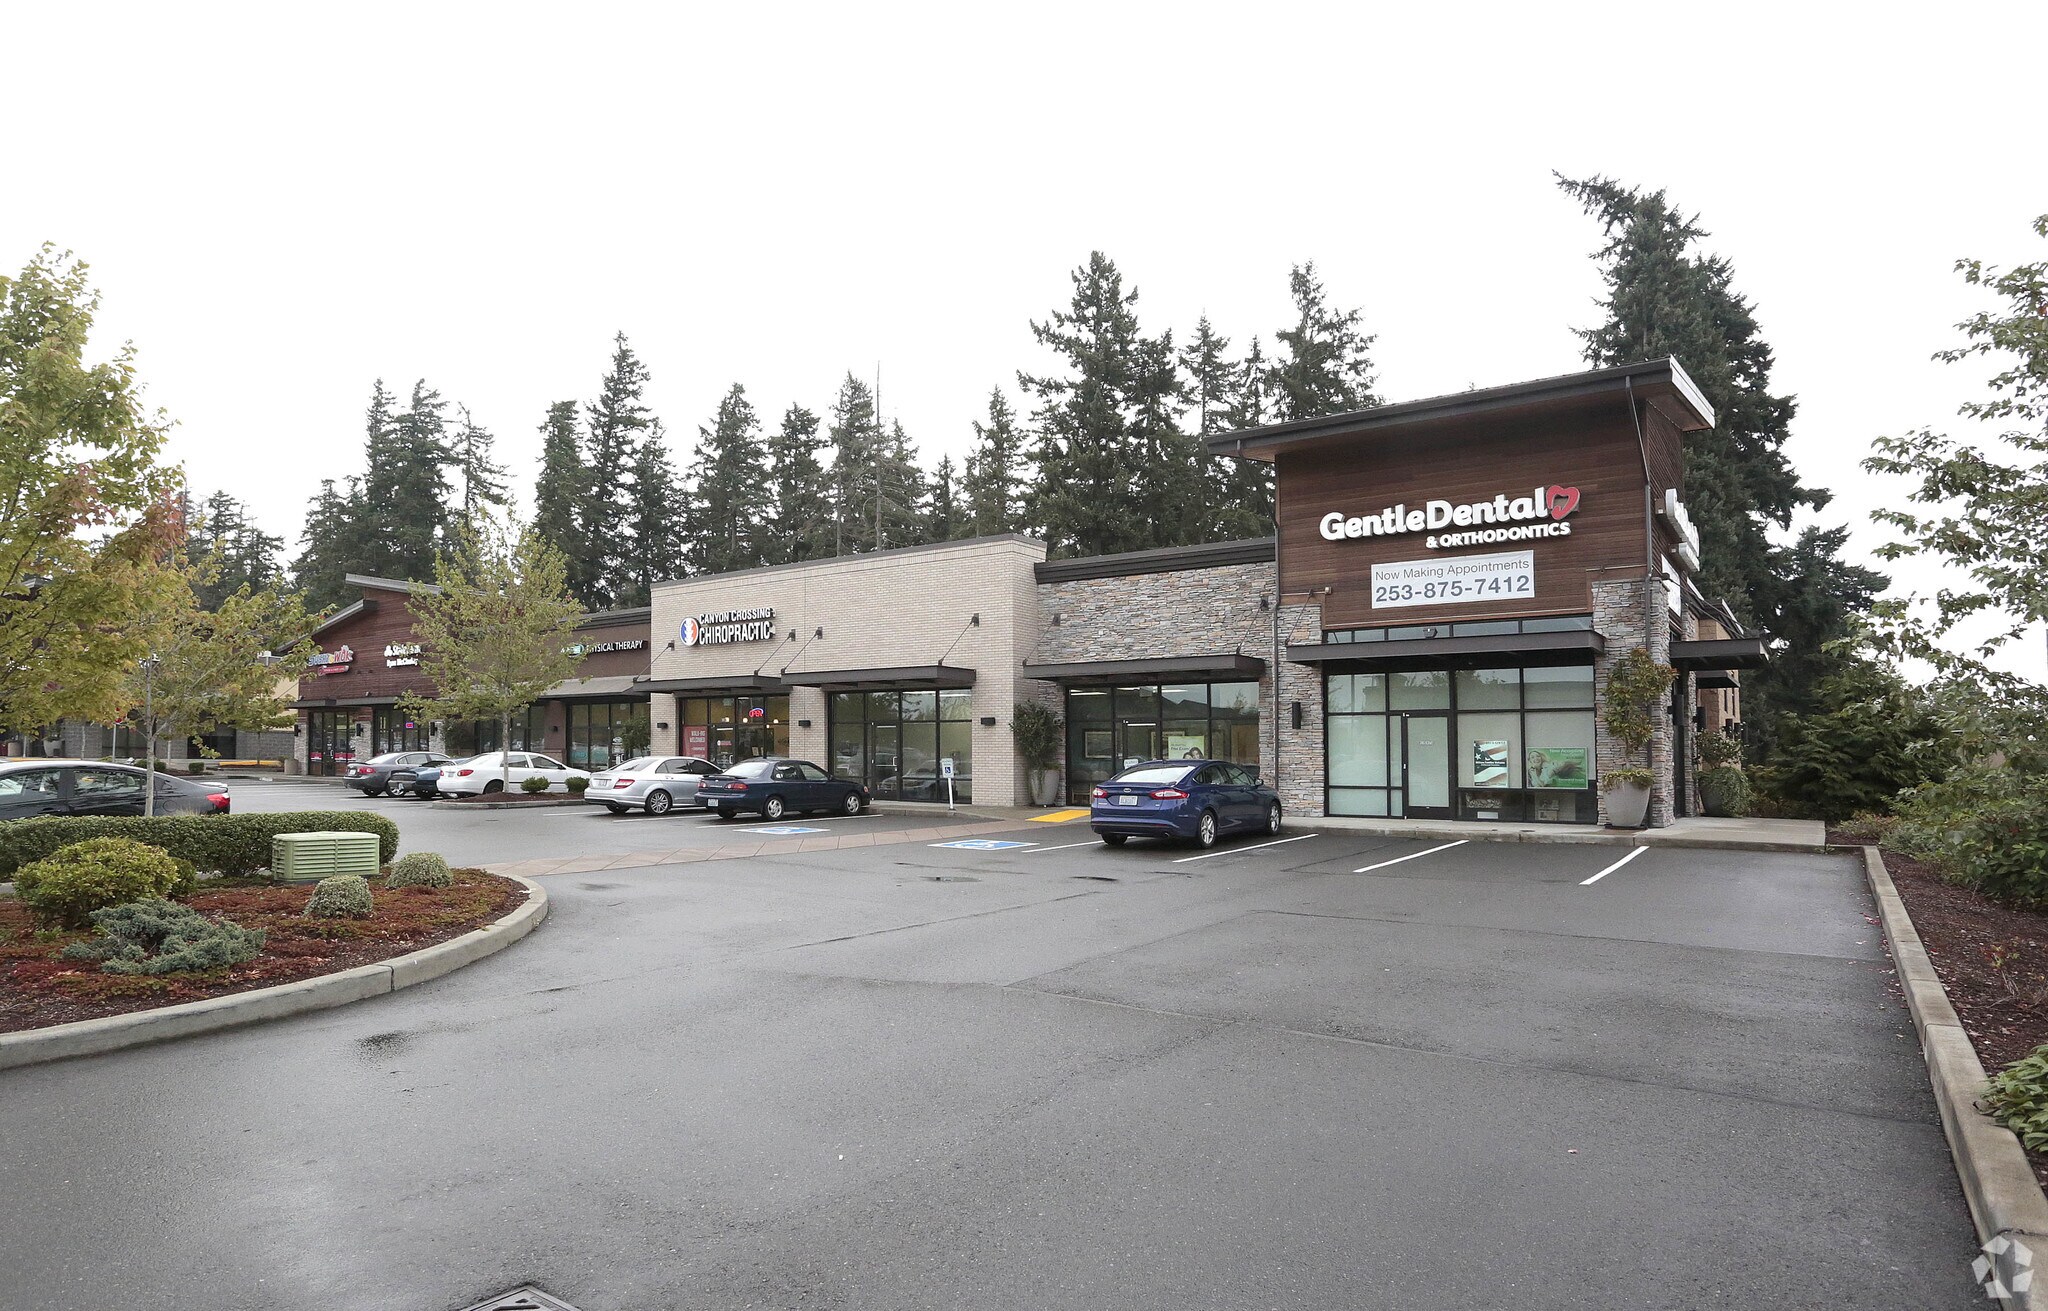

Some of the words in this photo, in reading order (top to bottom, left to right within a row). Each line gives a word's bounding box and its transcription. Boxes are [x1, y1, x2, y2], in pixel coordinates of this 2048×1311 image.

[1426, 536, 1439, 549] &
[1440, 522, 1571, 547] ORTHODONTICS
[1375, 571, 1400, 581] Now
[1403, 566, 1444, 579] Making
[1447, 559, 1530, 577] Appointments
[1375, 575, 1530, 602] 253-875-7412
[615, 640, 643, 650] THERAPY
[699, 621, 771, 645] CHIROPRACTIC
